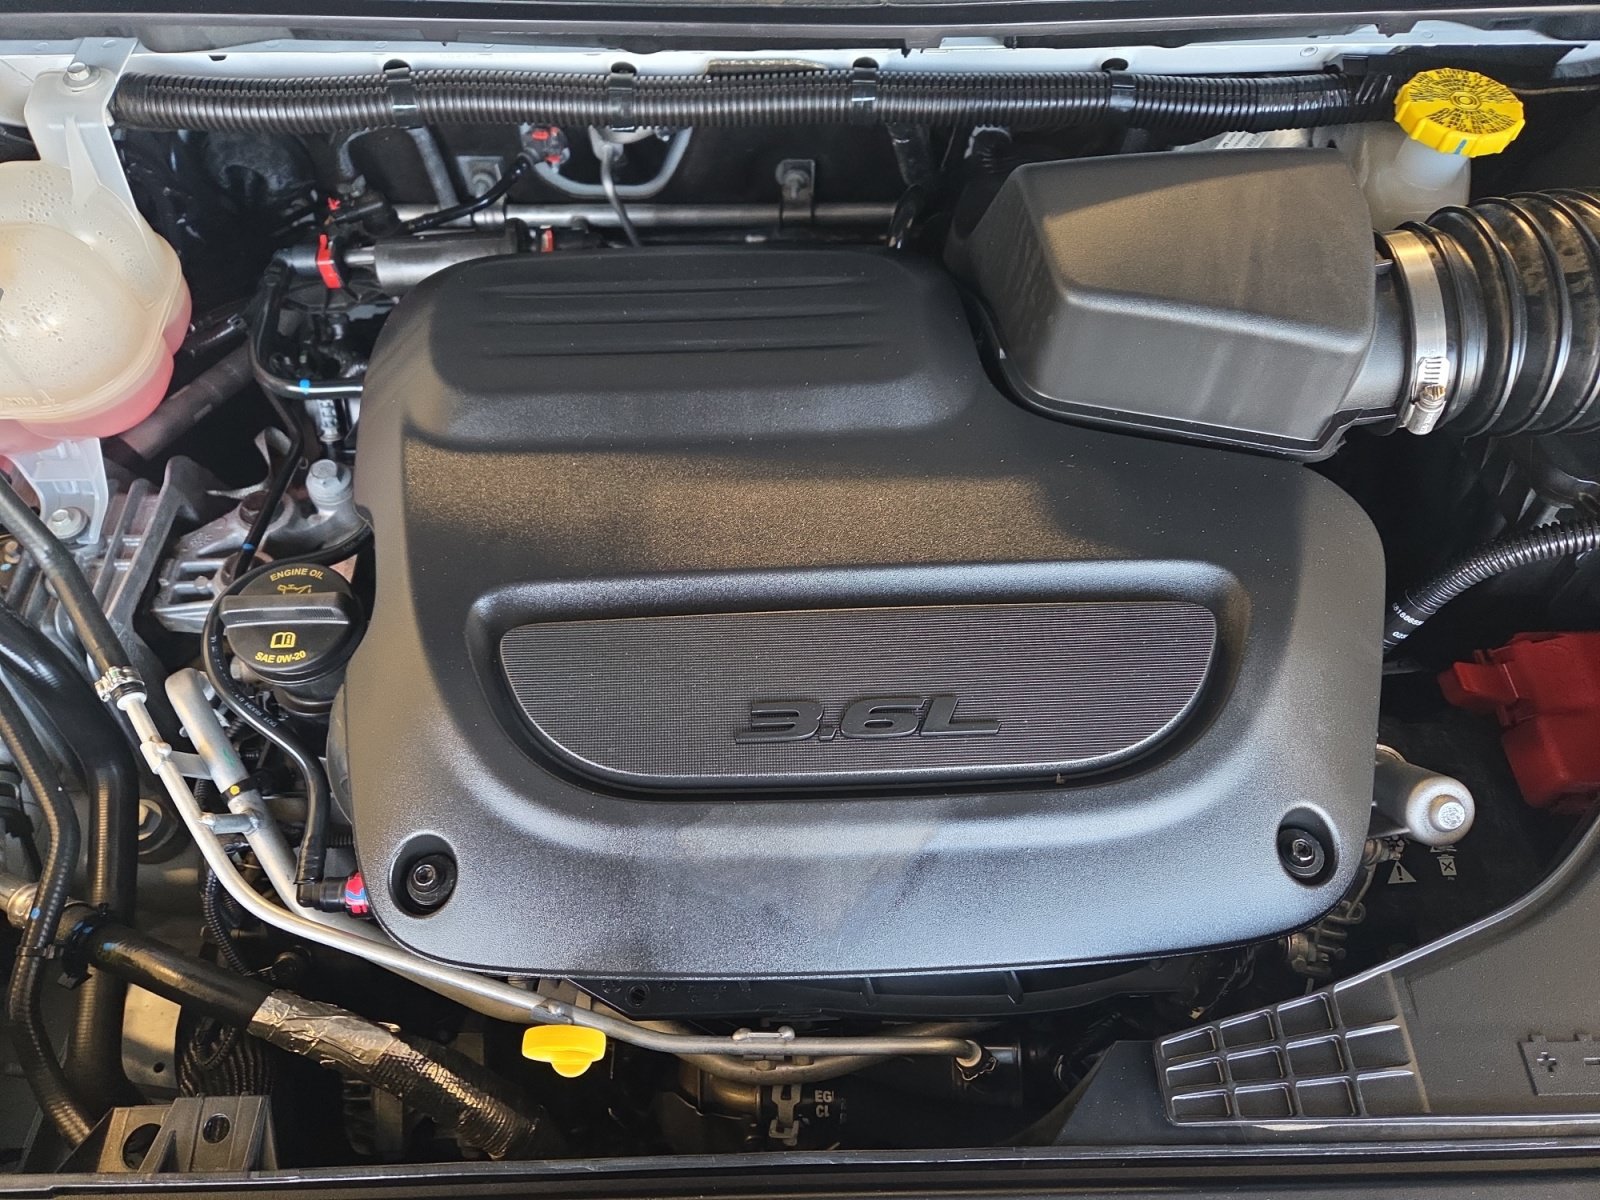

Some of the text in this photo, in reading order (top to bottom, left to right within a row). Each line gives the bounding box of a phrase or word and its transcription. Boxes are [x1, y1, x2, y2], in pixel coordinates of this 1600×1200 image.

[269, 567, 325, 582] ENGINE OIL
[255, 650, 307, 664] SAE 0W-20
[735, 695, 1002, 745] 3.6L
